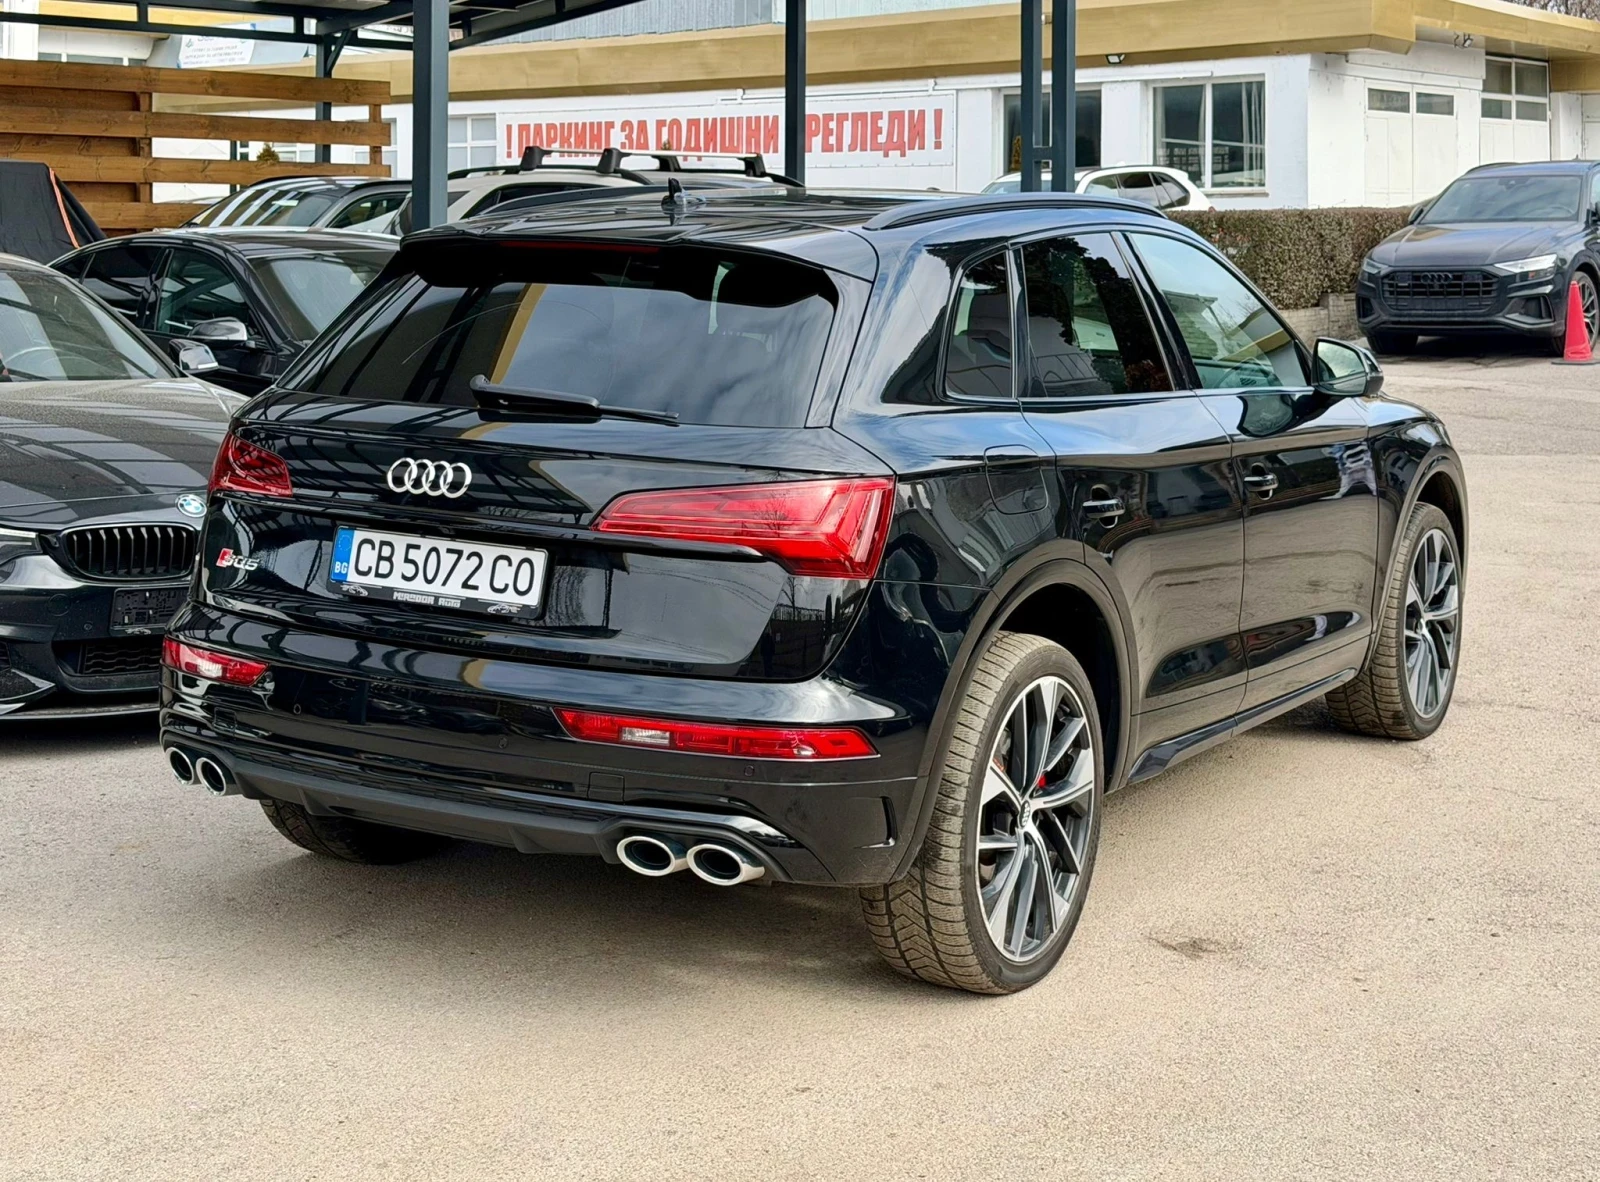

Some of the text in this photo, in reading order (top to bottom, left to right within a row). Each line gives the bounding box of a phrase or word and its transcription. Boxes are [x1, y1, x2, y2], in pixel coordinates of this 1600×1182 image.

[518, 121, 615, 158] ПАРКИНГ
[620, 119, 650, 151] ЗА
[655, 115, 780, 162] ГОДИШНИ
[804, 109, 926, 157] РЕГЛЕДИ
[334, 561, 348, 574] BG
[400, 543, 484, 592] 5072
